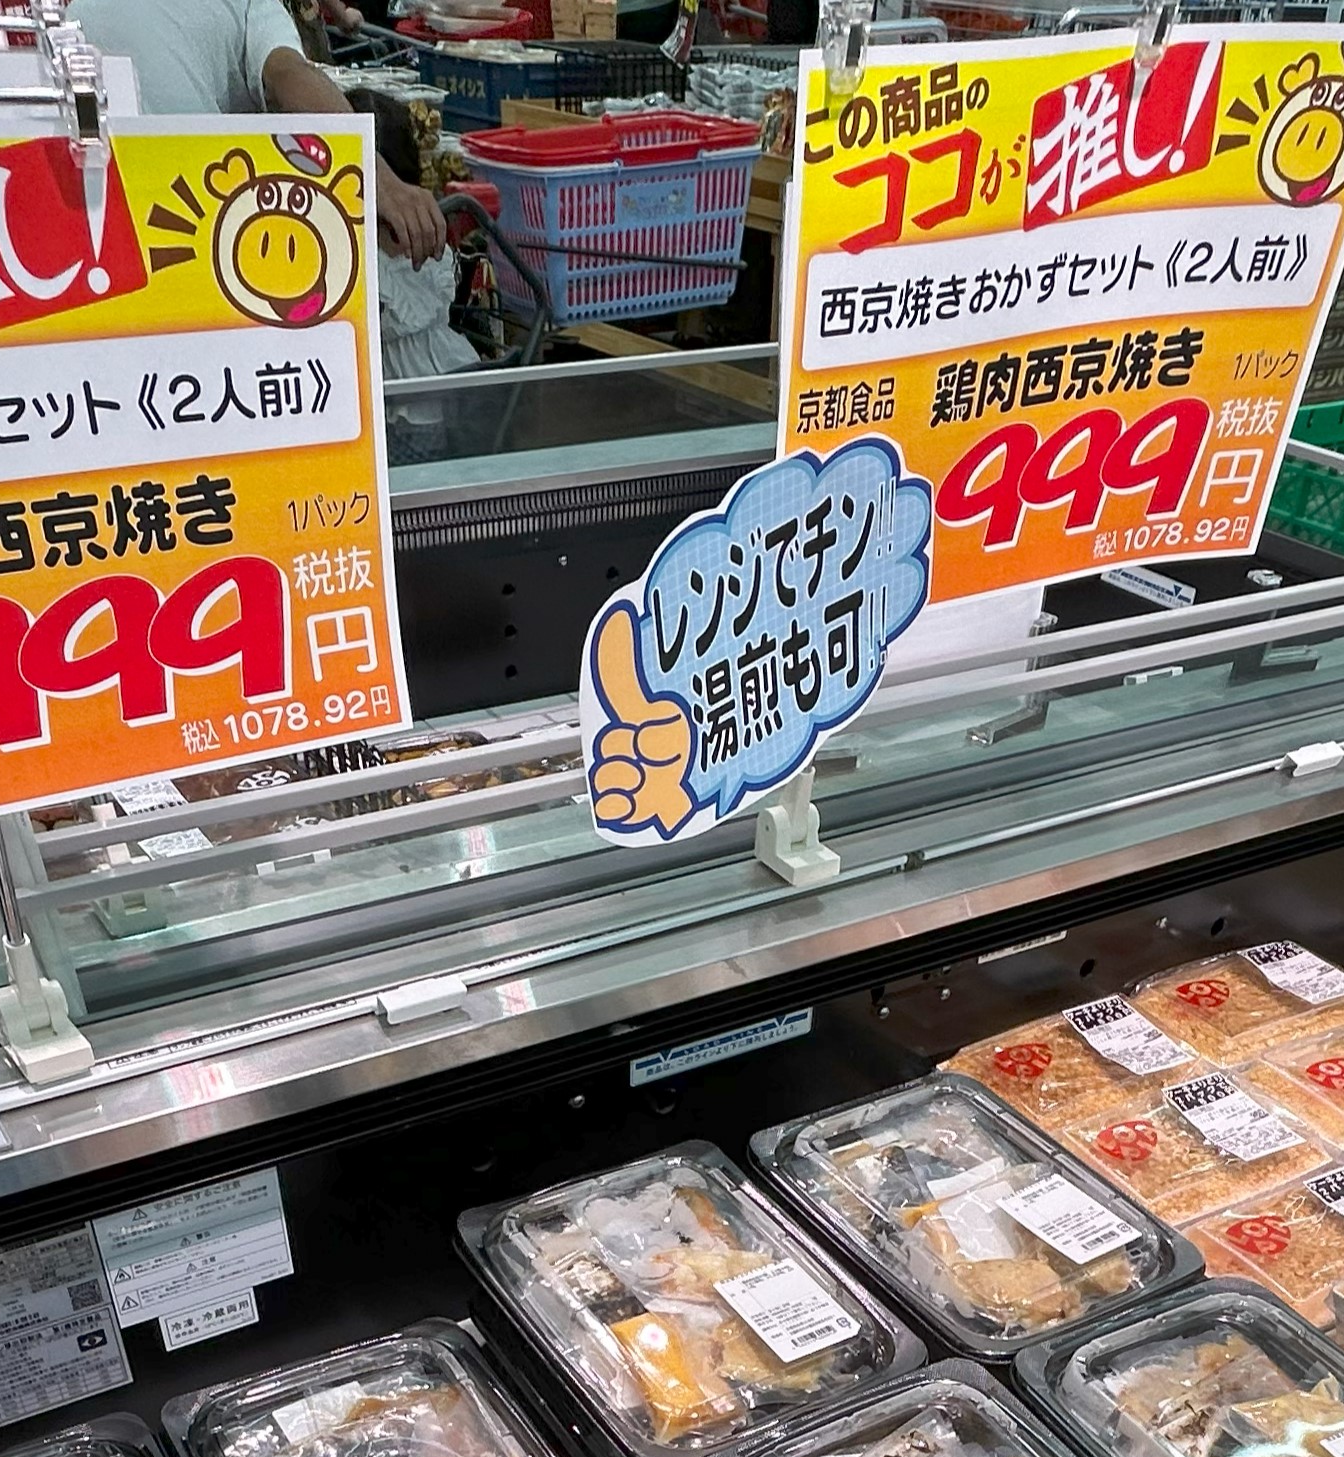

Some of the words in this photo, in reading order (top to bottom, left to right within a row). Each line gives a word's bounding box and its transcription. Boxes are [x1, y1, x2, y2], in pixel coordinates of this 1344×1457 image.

[804, 63, 990, 164] この商品の
[798, 377, 896, 435] 京都食品
[931, 327, 1205, 428] 鶏肉西京焼き
[1234, 350, 1299, 381] 1パック
[1216, 399, 1276, 437] 税抜
[935, 398, 1211, 550] 999
[1201, 448, 1257, 508] 円
[290, 490, 370, 533] 1パック
[293, 546, 374, 598] 税抜
[309, 607, 378, 681] 円
